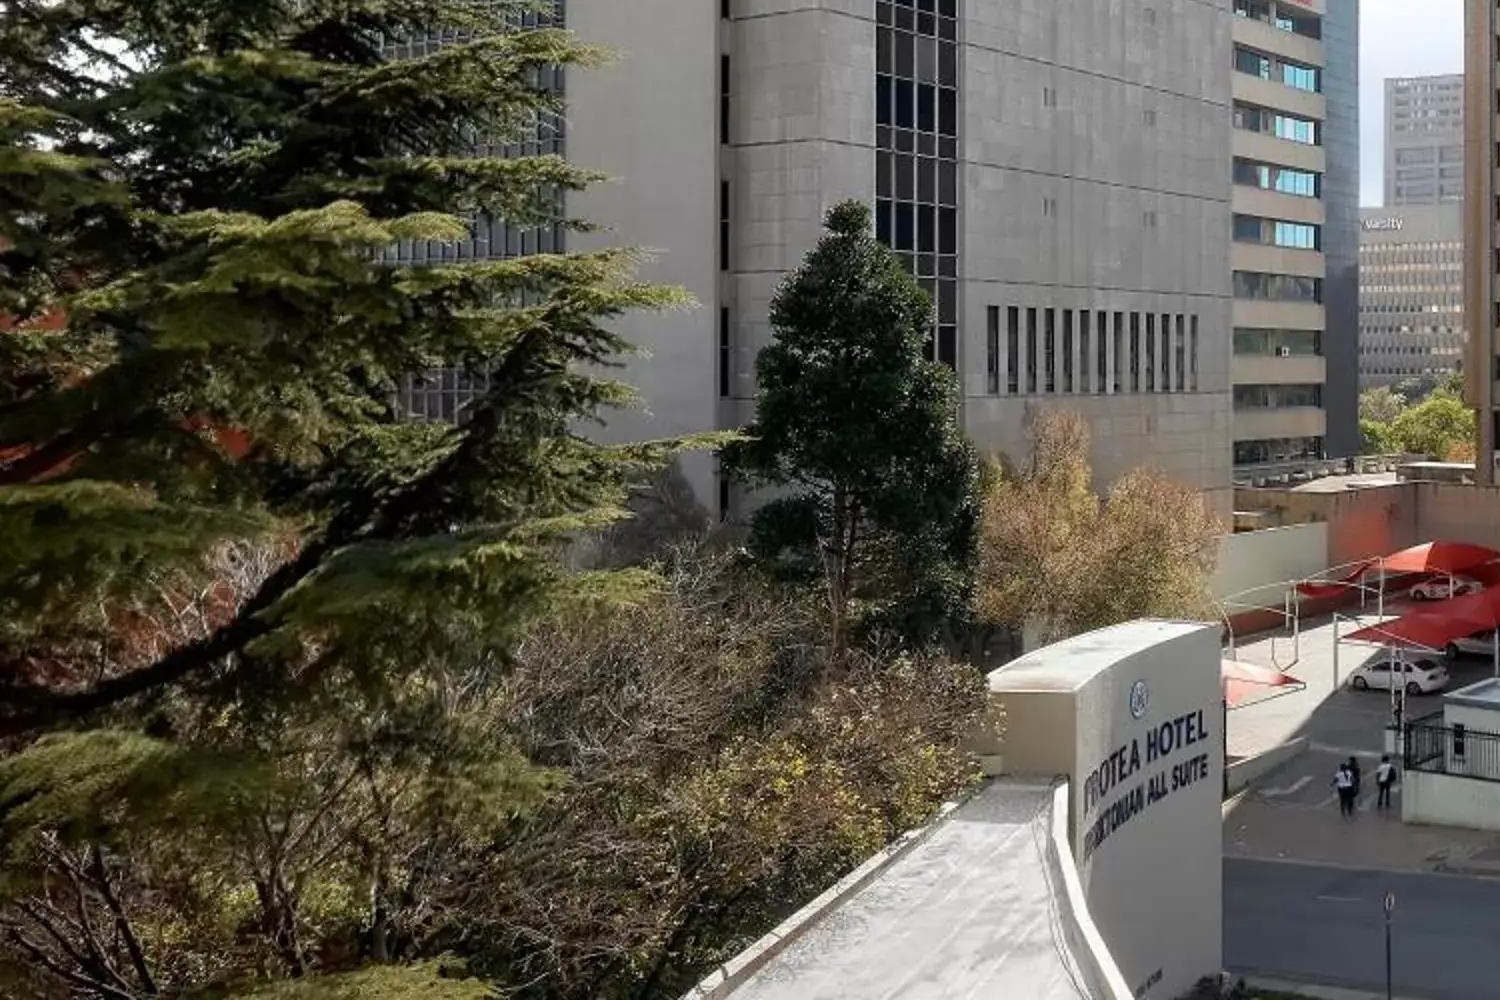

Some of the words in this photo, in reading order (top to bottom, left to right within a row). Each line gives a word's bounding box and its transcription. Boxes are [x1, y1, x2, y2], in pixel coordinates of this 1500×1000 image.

[1084, 739, 1141, 820] PROTEA
[1146, 709, 1208, 764] HOTEL
[1147, 770, 1169, 806] ALL
[1171, 753, 1208, 792] SUITE
